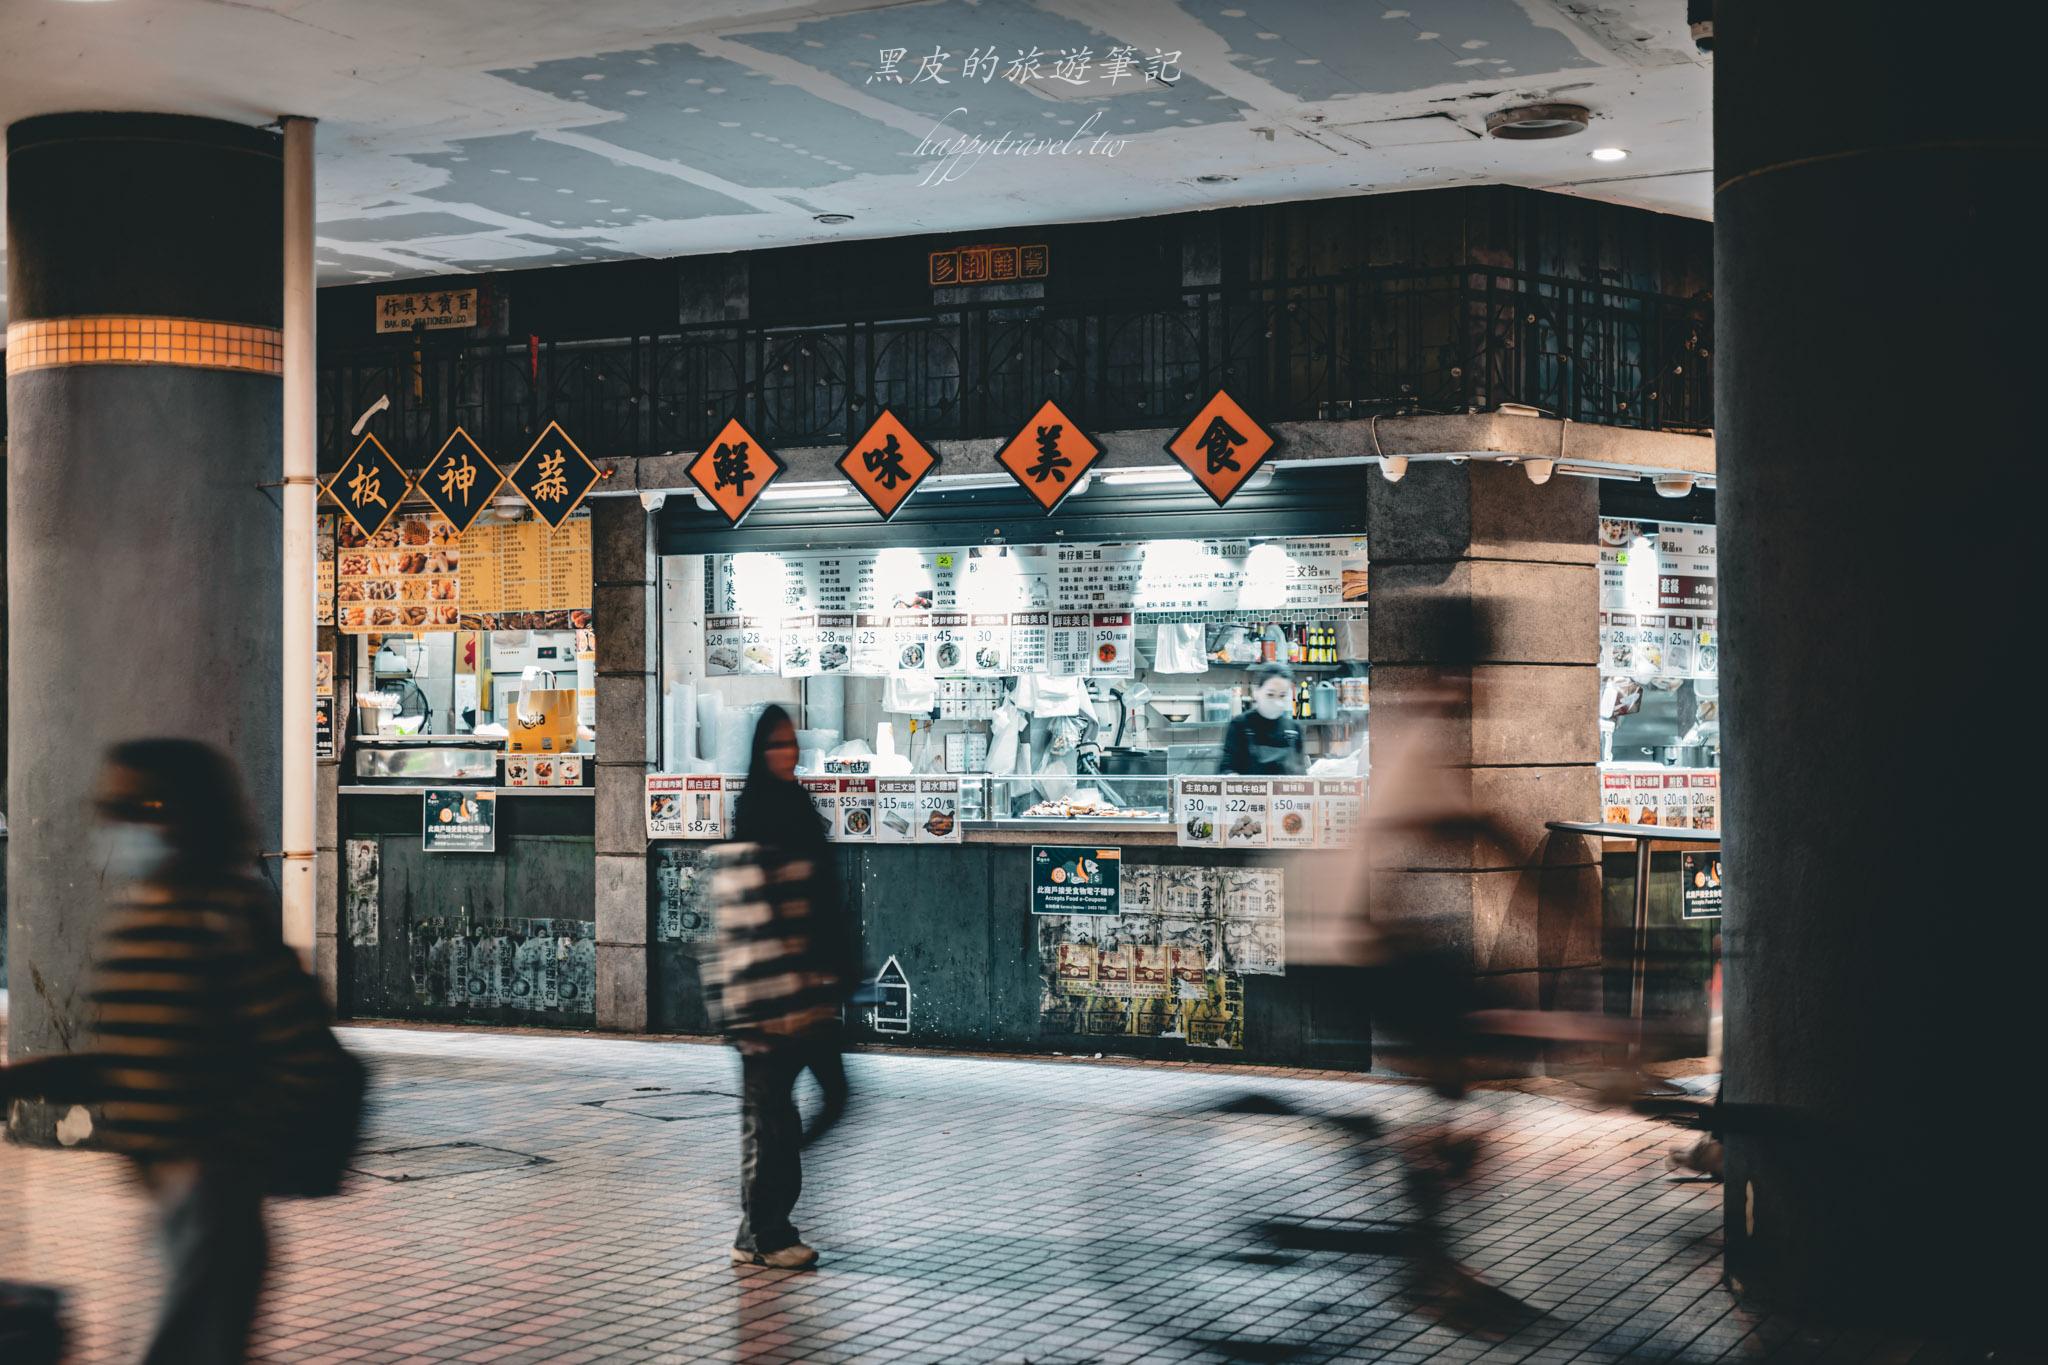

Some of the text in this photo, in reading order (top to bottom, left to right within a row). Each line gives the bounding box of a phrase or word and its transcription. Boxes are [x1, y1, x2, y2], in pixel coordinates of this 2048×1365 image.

[713, 441, 755, 496] 鮮
[862, 434, 911, 489] 味
[1026, 424, 1072, 483] 美
[1196, 416, 1248, 475] 食
[348, 463, 388, 509] 板
[438, 454, 477, 507] 神
[1054, 615, 1089, 627] 鮮味美食
[1186, 784, 1218, 793] 生菜魚肉
[687, 821, 719, 832] $8/支
[1037, 886, 1116, 897] 此商戶接受食物電子禮券
